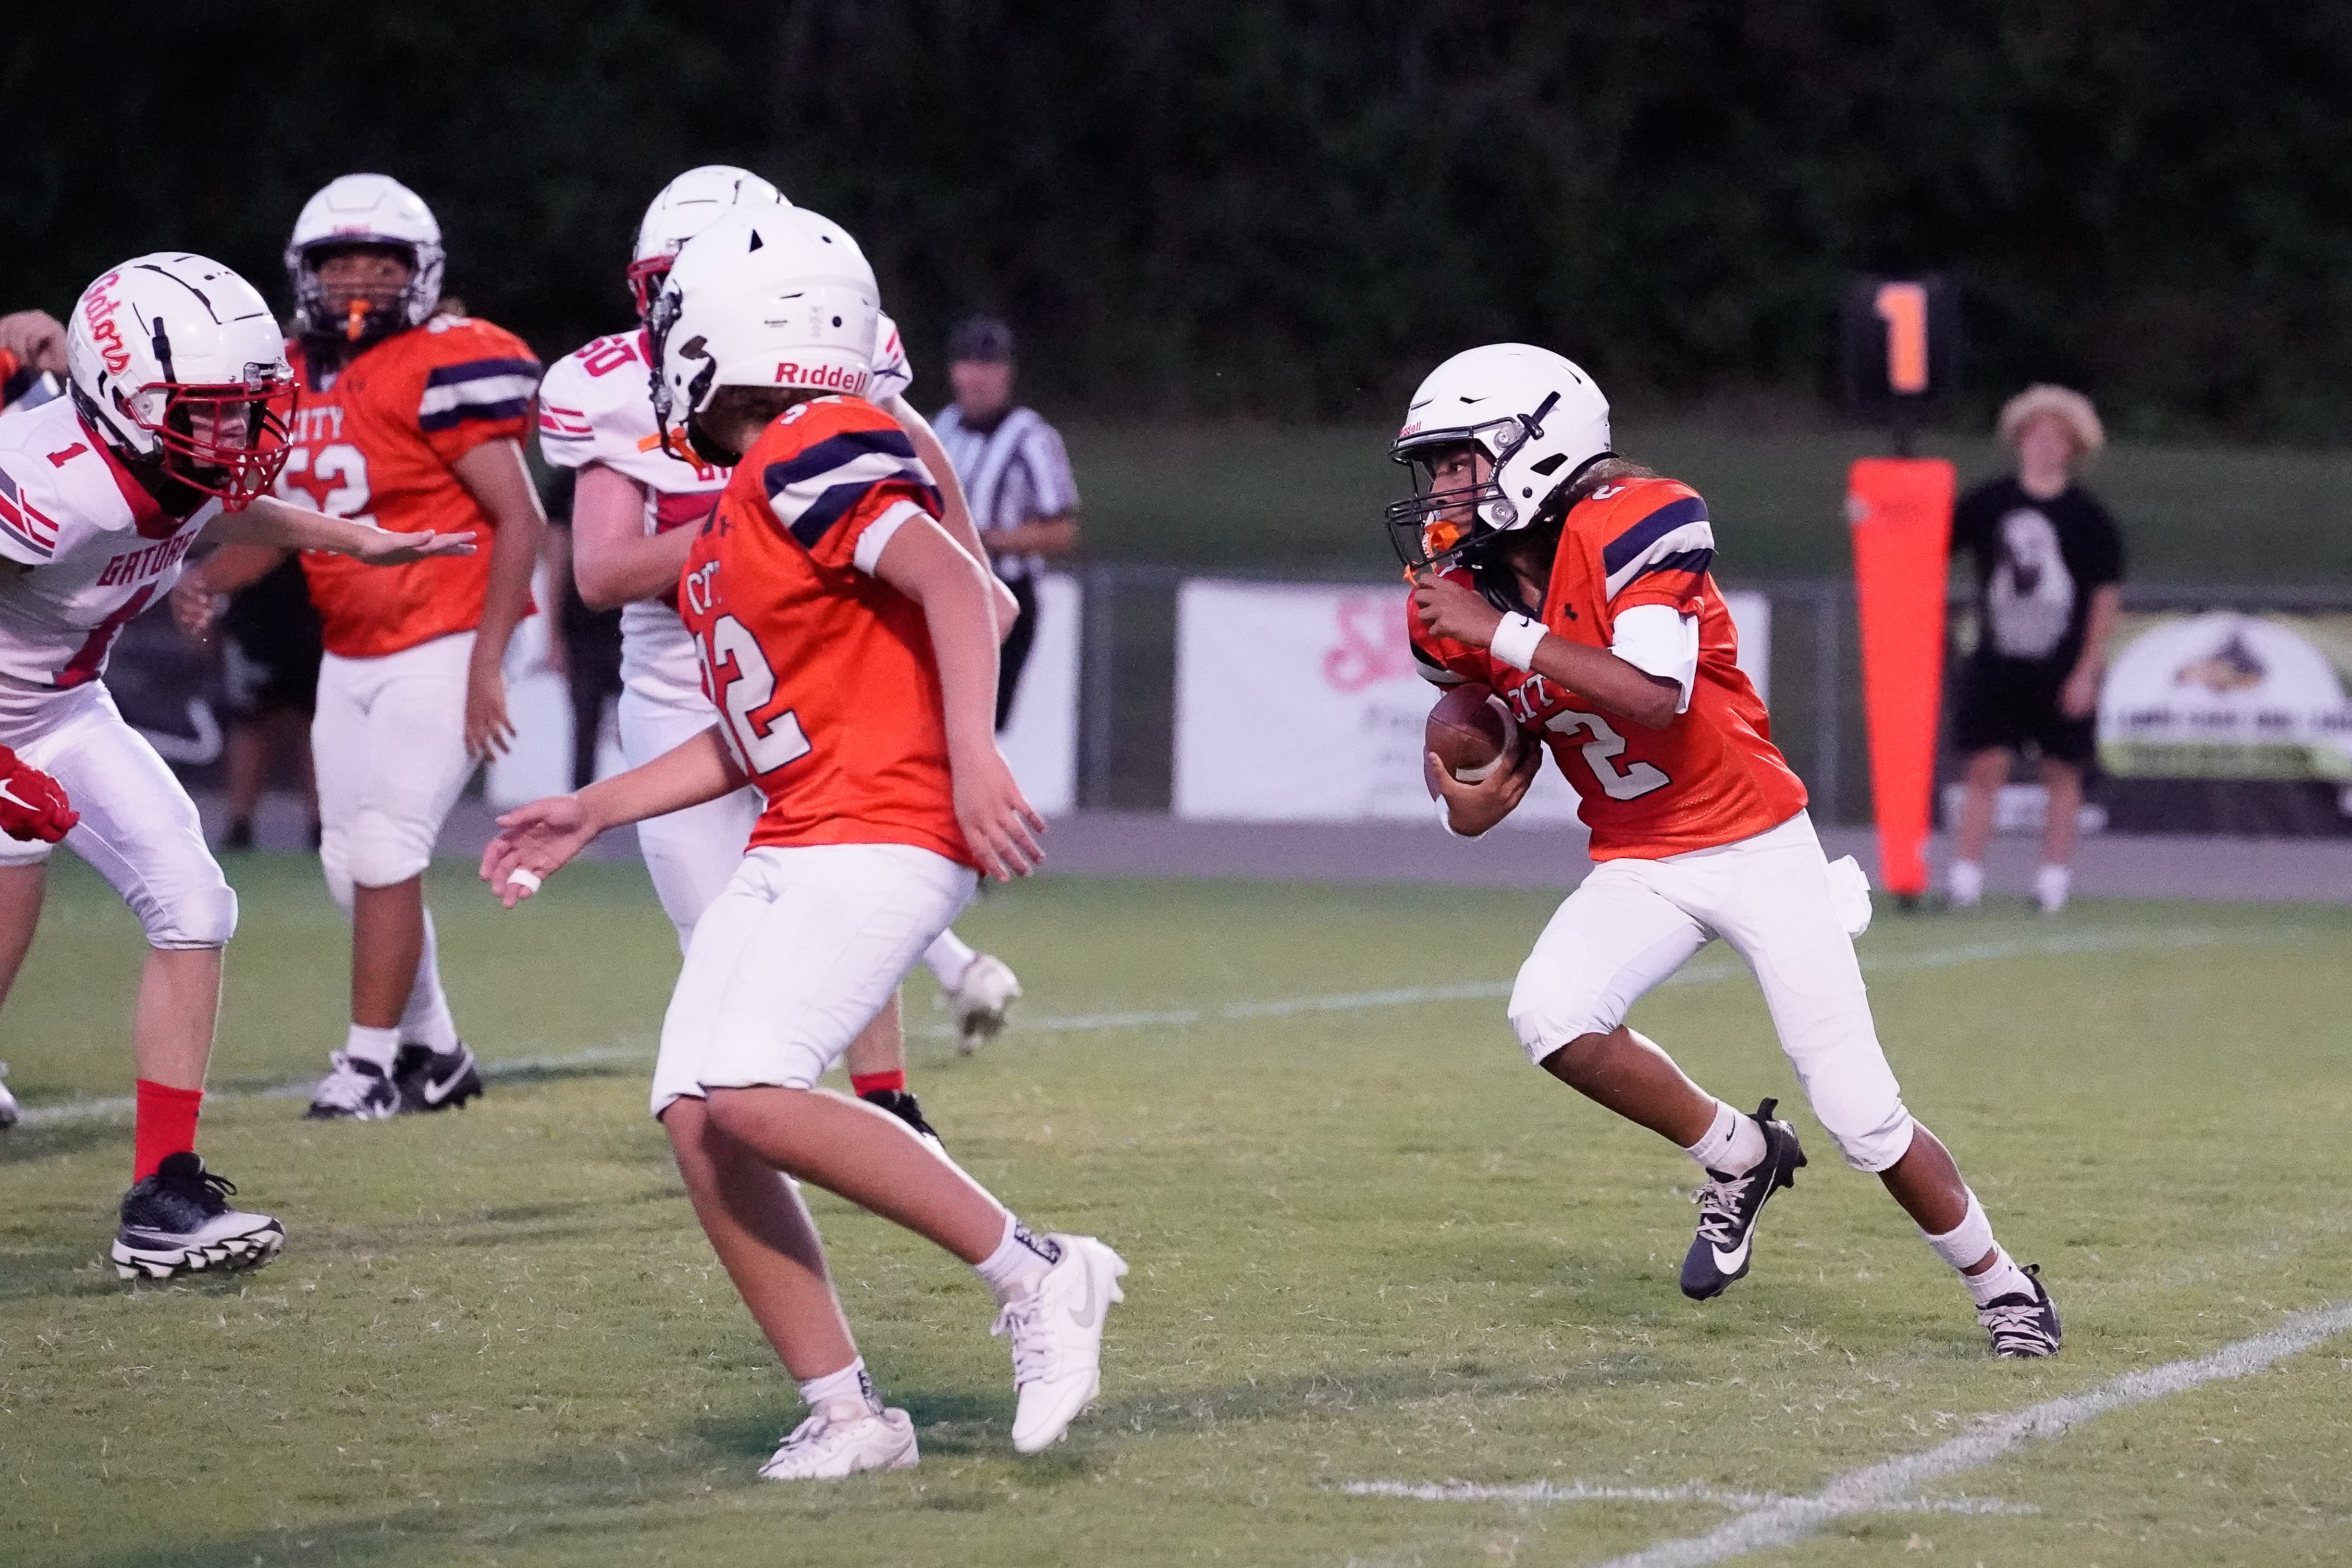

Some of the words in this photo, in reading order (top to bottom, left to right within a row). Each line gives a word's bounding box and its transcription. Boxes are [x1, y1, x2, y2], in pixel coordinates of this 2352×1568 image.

[83, 272, 130, 375] Gators
[1875, 283, 1928, 392] 1
[775, 363, 867, 393] Riddell
[46, 442, 89, 468] 1
[274, 443, 378, 527] 52
[54, 579, 159, 688] 1
[695, 614, 812, 776] 2
[1544, 709, 1671, 801] 2
